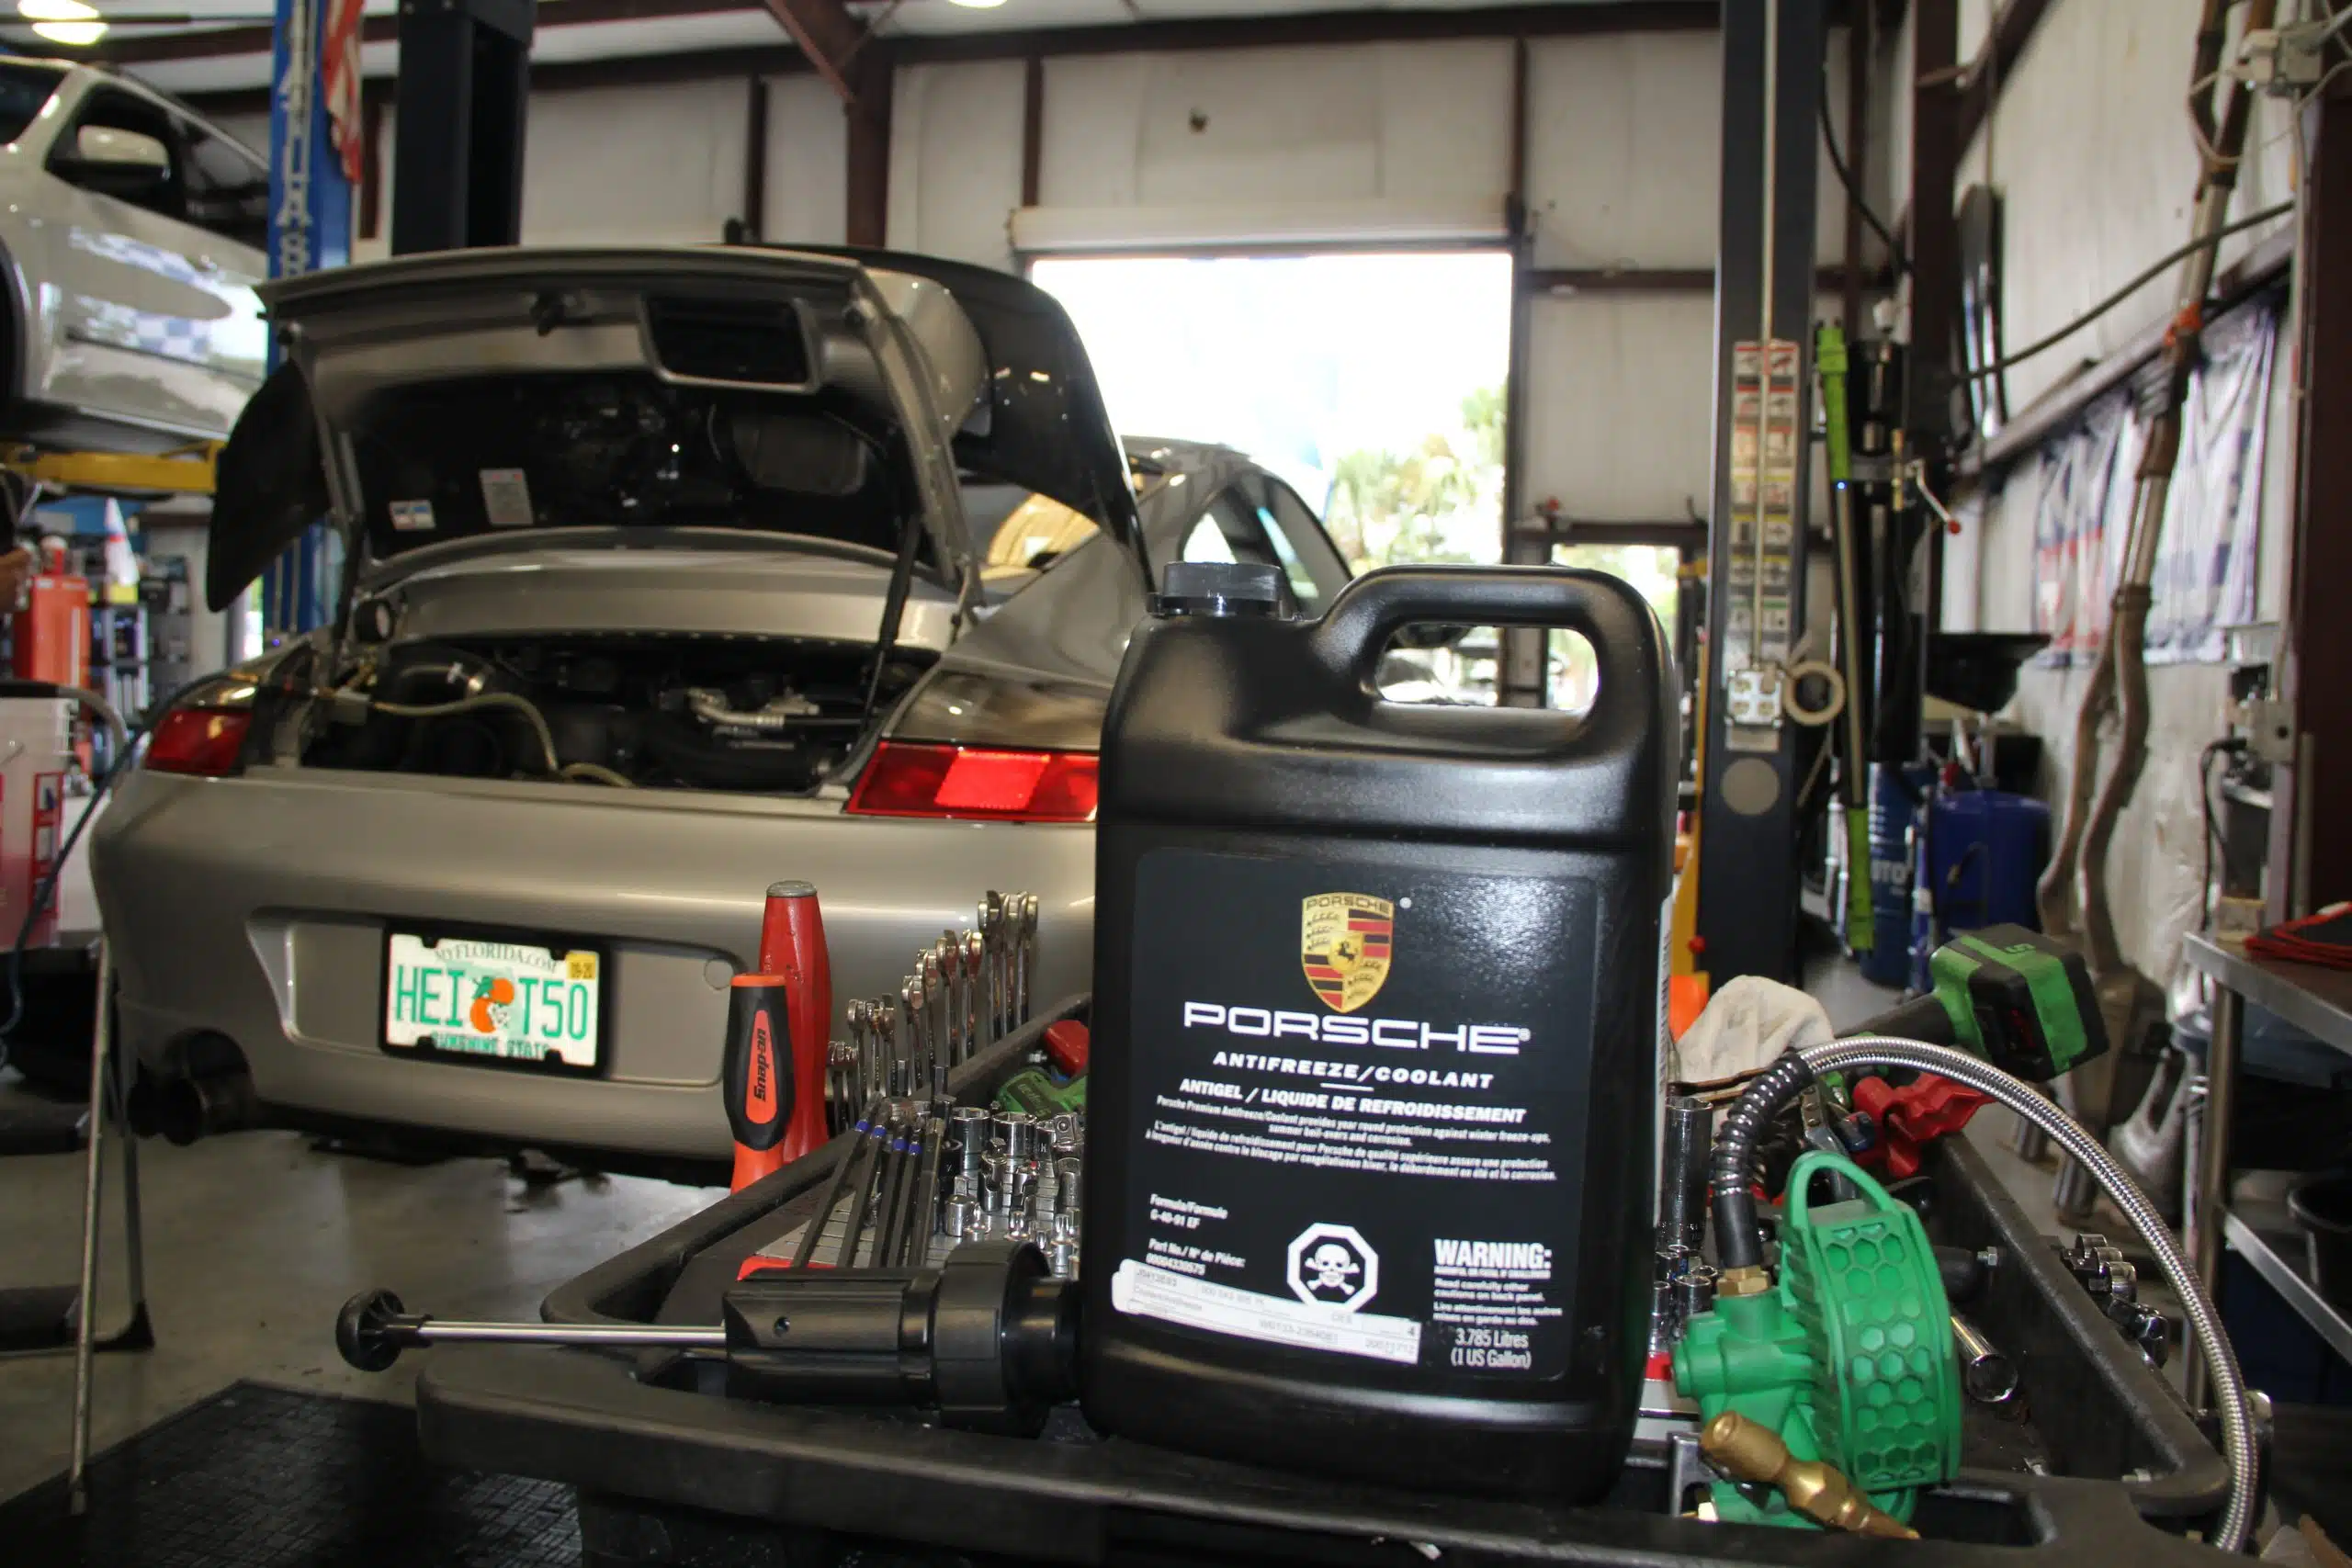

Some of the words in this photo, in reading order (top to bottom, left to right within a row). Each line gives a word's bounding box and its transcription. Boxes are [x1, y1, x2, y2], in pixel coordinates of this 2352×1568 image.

[1306, 896, 1389, 913] PORSCHE
[435, 942, 557, 974] MYFLORIDA.COM
[396, 964, 465, 1027] HEI
[517, 976, 588, 1040] T50
[1212, 1051, 1494, 1089] ANTIFREEZE/COOLANT
[1179, 1078, 1243, 1100] ANTIGEL
[1244, 1088, 1259, 1103] /
[1261, 1089, 1328, 1111] LIQUIDE
[1330, 1096, 1355, 1111] DE
[1359, 1098, 1527, 1124] REFROIDISSEMENT
[1157, 1094, 1186, 1110] Porsche
[1298, 1115, 1336, 1129] provides
[1358, 1122, 1385, 1134] round
[1385, 1124, 1432, 1138] protection
[1432, 1127, 1468, 1140] against
[1468, 1129, 1498, 1141] winter
[1268, 1124, 1303, 1136] summer
[1349, 1132, 1367, 1143] and
[1317, 1142, 1353, 1157] Porsche
[1148, 1237, 1168, 1253] Part
[1434, 1238, 1553, 1269] WARNING:
[1454, 1327, 1492, 1348] 3.785
[1493, 1329, 1530, 1349] Litres
[1450, 1347, 1464, 1368] (1
[1465, 1348, 1487, 1367] US
[1487, 1348, 1532, 1371] Gallon)
